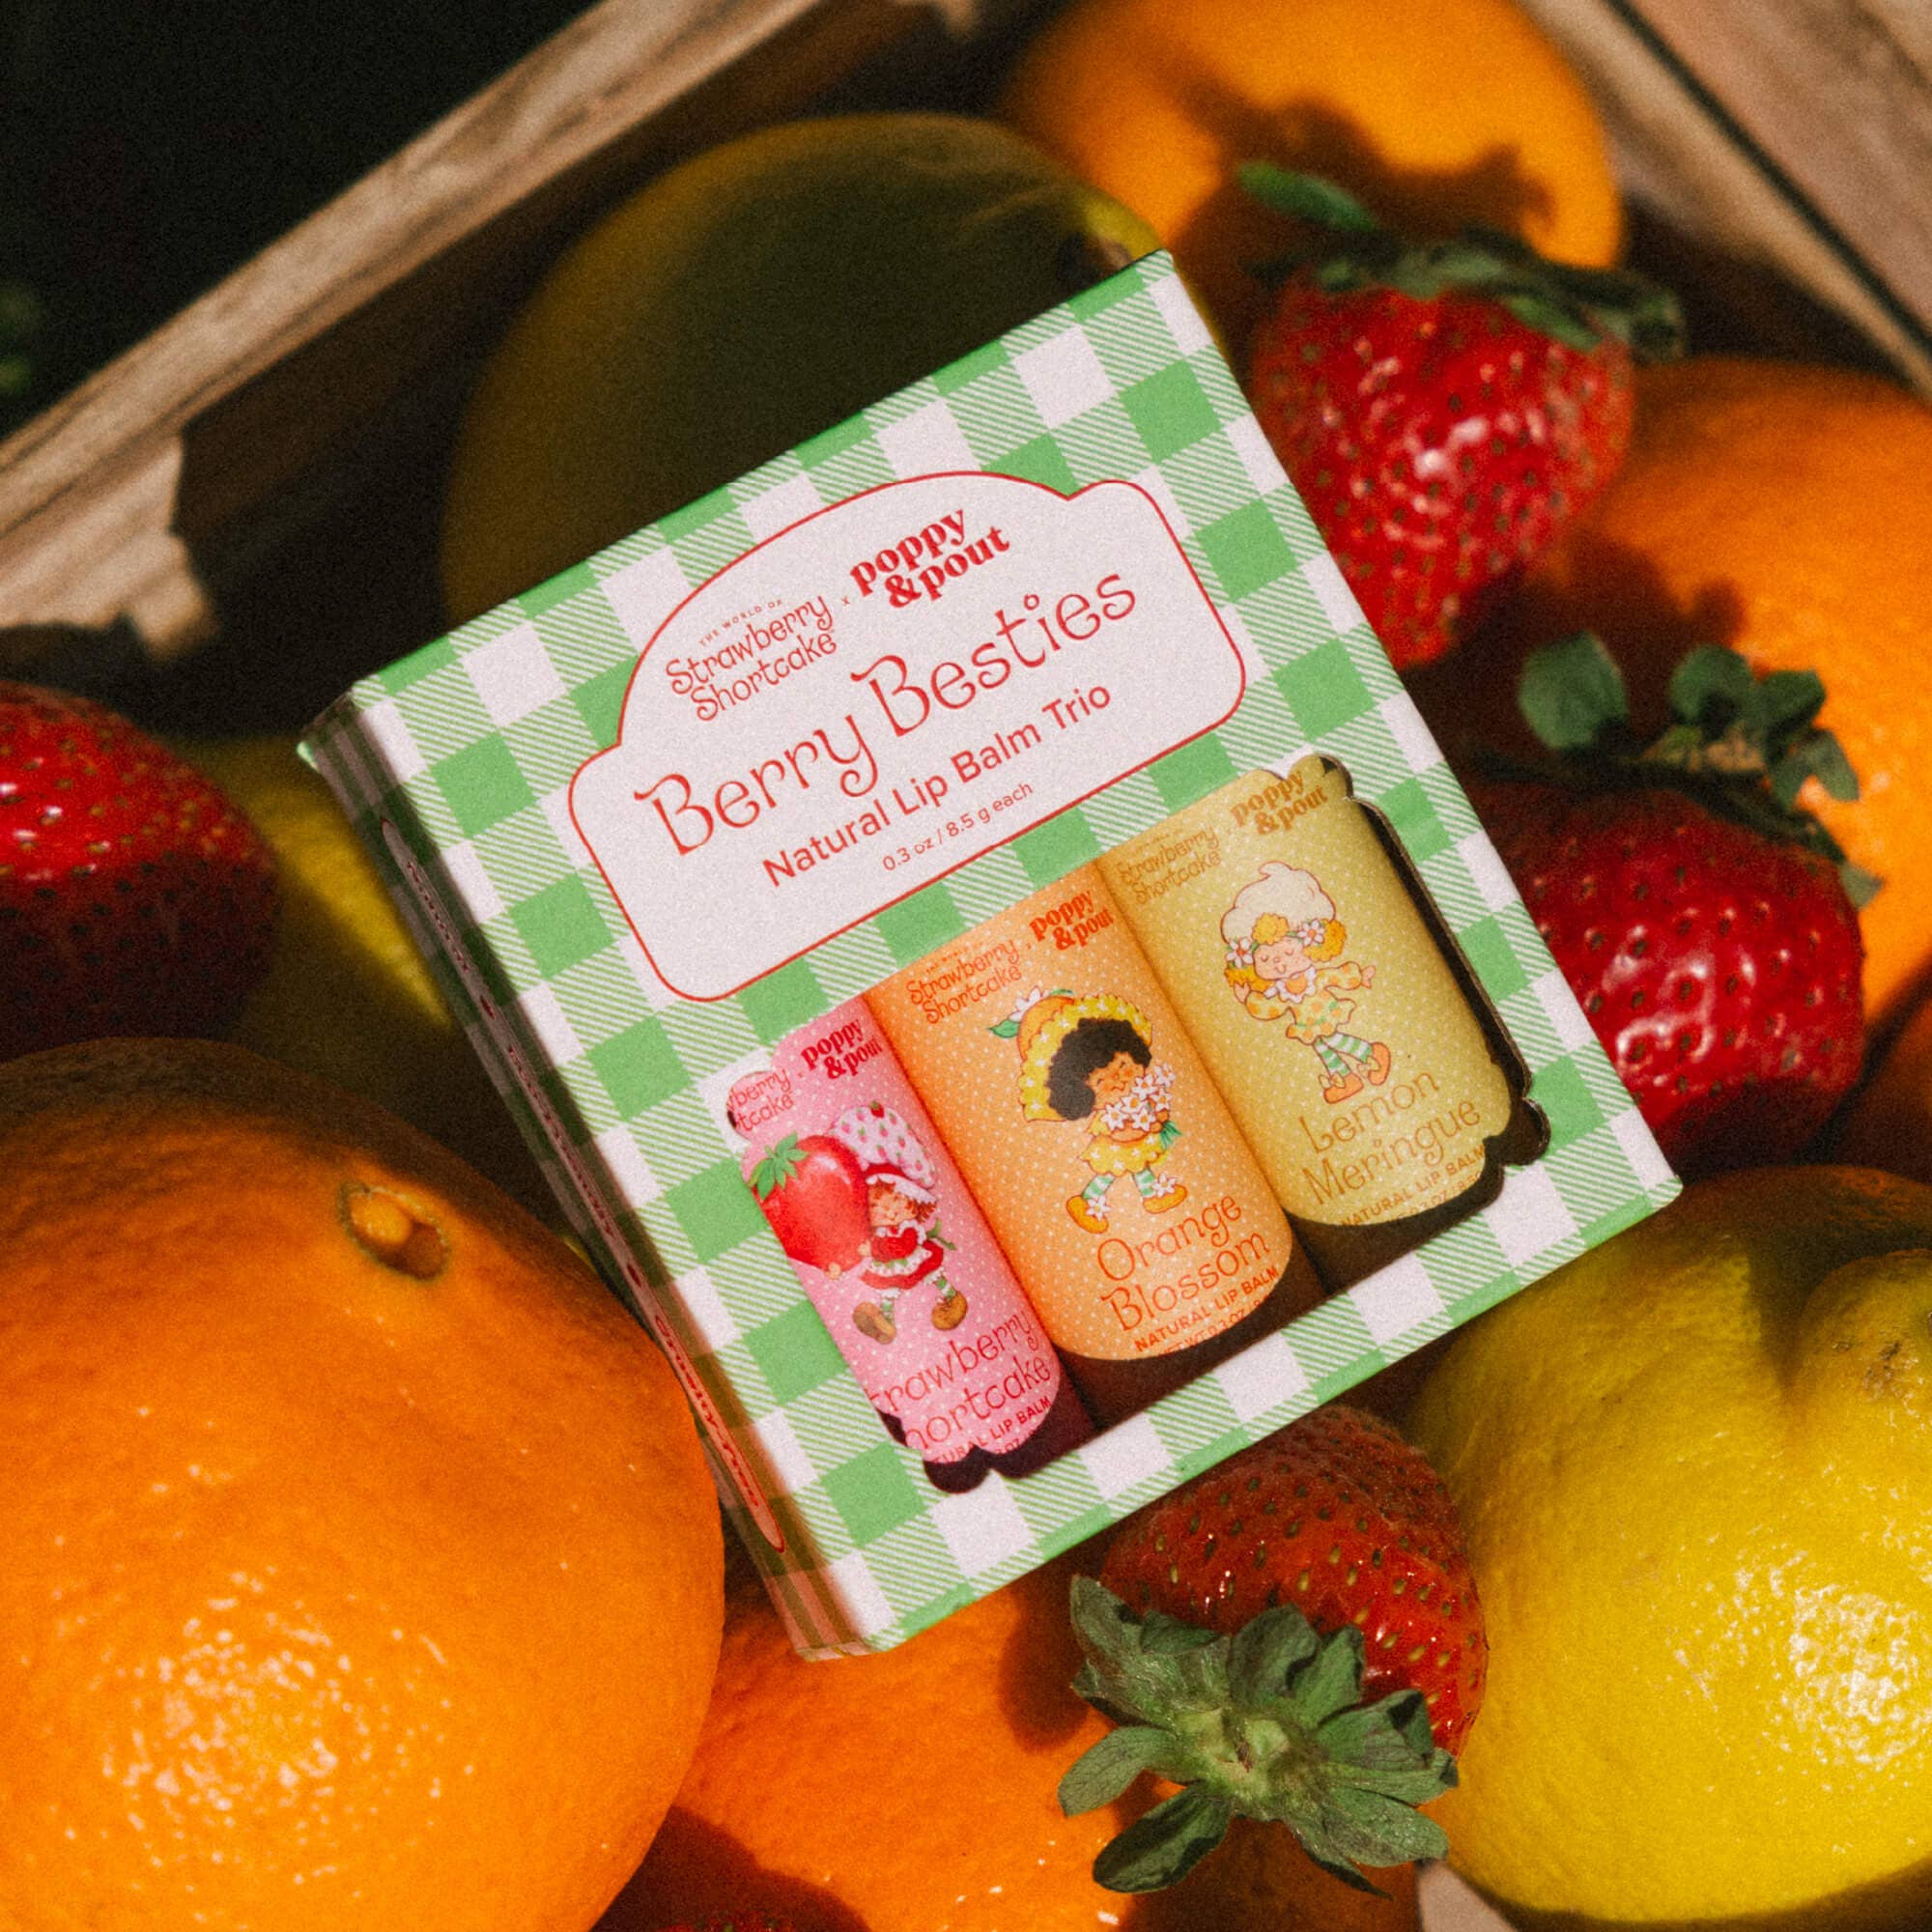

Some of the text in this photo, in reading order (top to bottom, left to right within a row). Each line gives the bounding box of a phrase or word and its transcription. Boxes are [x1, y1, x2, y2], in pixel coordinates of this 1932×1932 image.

[885, 526, 1010, 608] &pout
[666, 596, 833, 695] Strawberry
[849, 508, 965, 597] poppy
[698, 629, 720, 646] THE
[722, 605, 763, 628] WORLD
[634, 573, 1136, 855] Berry Besties
[762, 685, 1111, 887] Natural Lip Balm Trio
[1231, 770, 1304, 827] poppy
[1255, 785, 1328, 835] &pout
[883, 847, 910, 871] 0.3
[913, 838, 934, 855] oz
[946, 813, 975, 837] 8.5
[978, 808, 991, 824] g
[992, 782, 1034, 811] each
[1118, 826, 1220, 885] Strawberry
[1132, 850, 1221, 905] Shortcake
[1030, 891, 1094, 942] poppy
[1052, 907, 1114, 951] &pout
[906, 940, 1020, 1005] Strawberry
[923, 966, 1022, 1024] Shortcake
[801, 1019, 864, 1071] poppy
[1298, 1071, 1438, 1153] Lemon
[1302, 1101, 1480, 1205] Meringue
[1415, 1171, 1440, 1192] LIP
[1445, 1144, 1486, 1177] BALM
[1097, 1196, 1241, 1281] Orange
[1100, 1233, 1270, 1331] Blossom
[1134, 1306, 1211, 1351] NATURAL
[1214, 1289, 1238, 1311] LIP
[1241, 1265, 1279, 1295] BALM
[865, 1311, 1038, 1411] trawberry
[990, 1419, 1012, 1439] LIP
[1016, 1396, 1051, 1426] BALM
